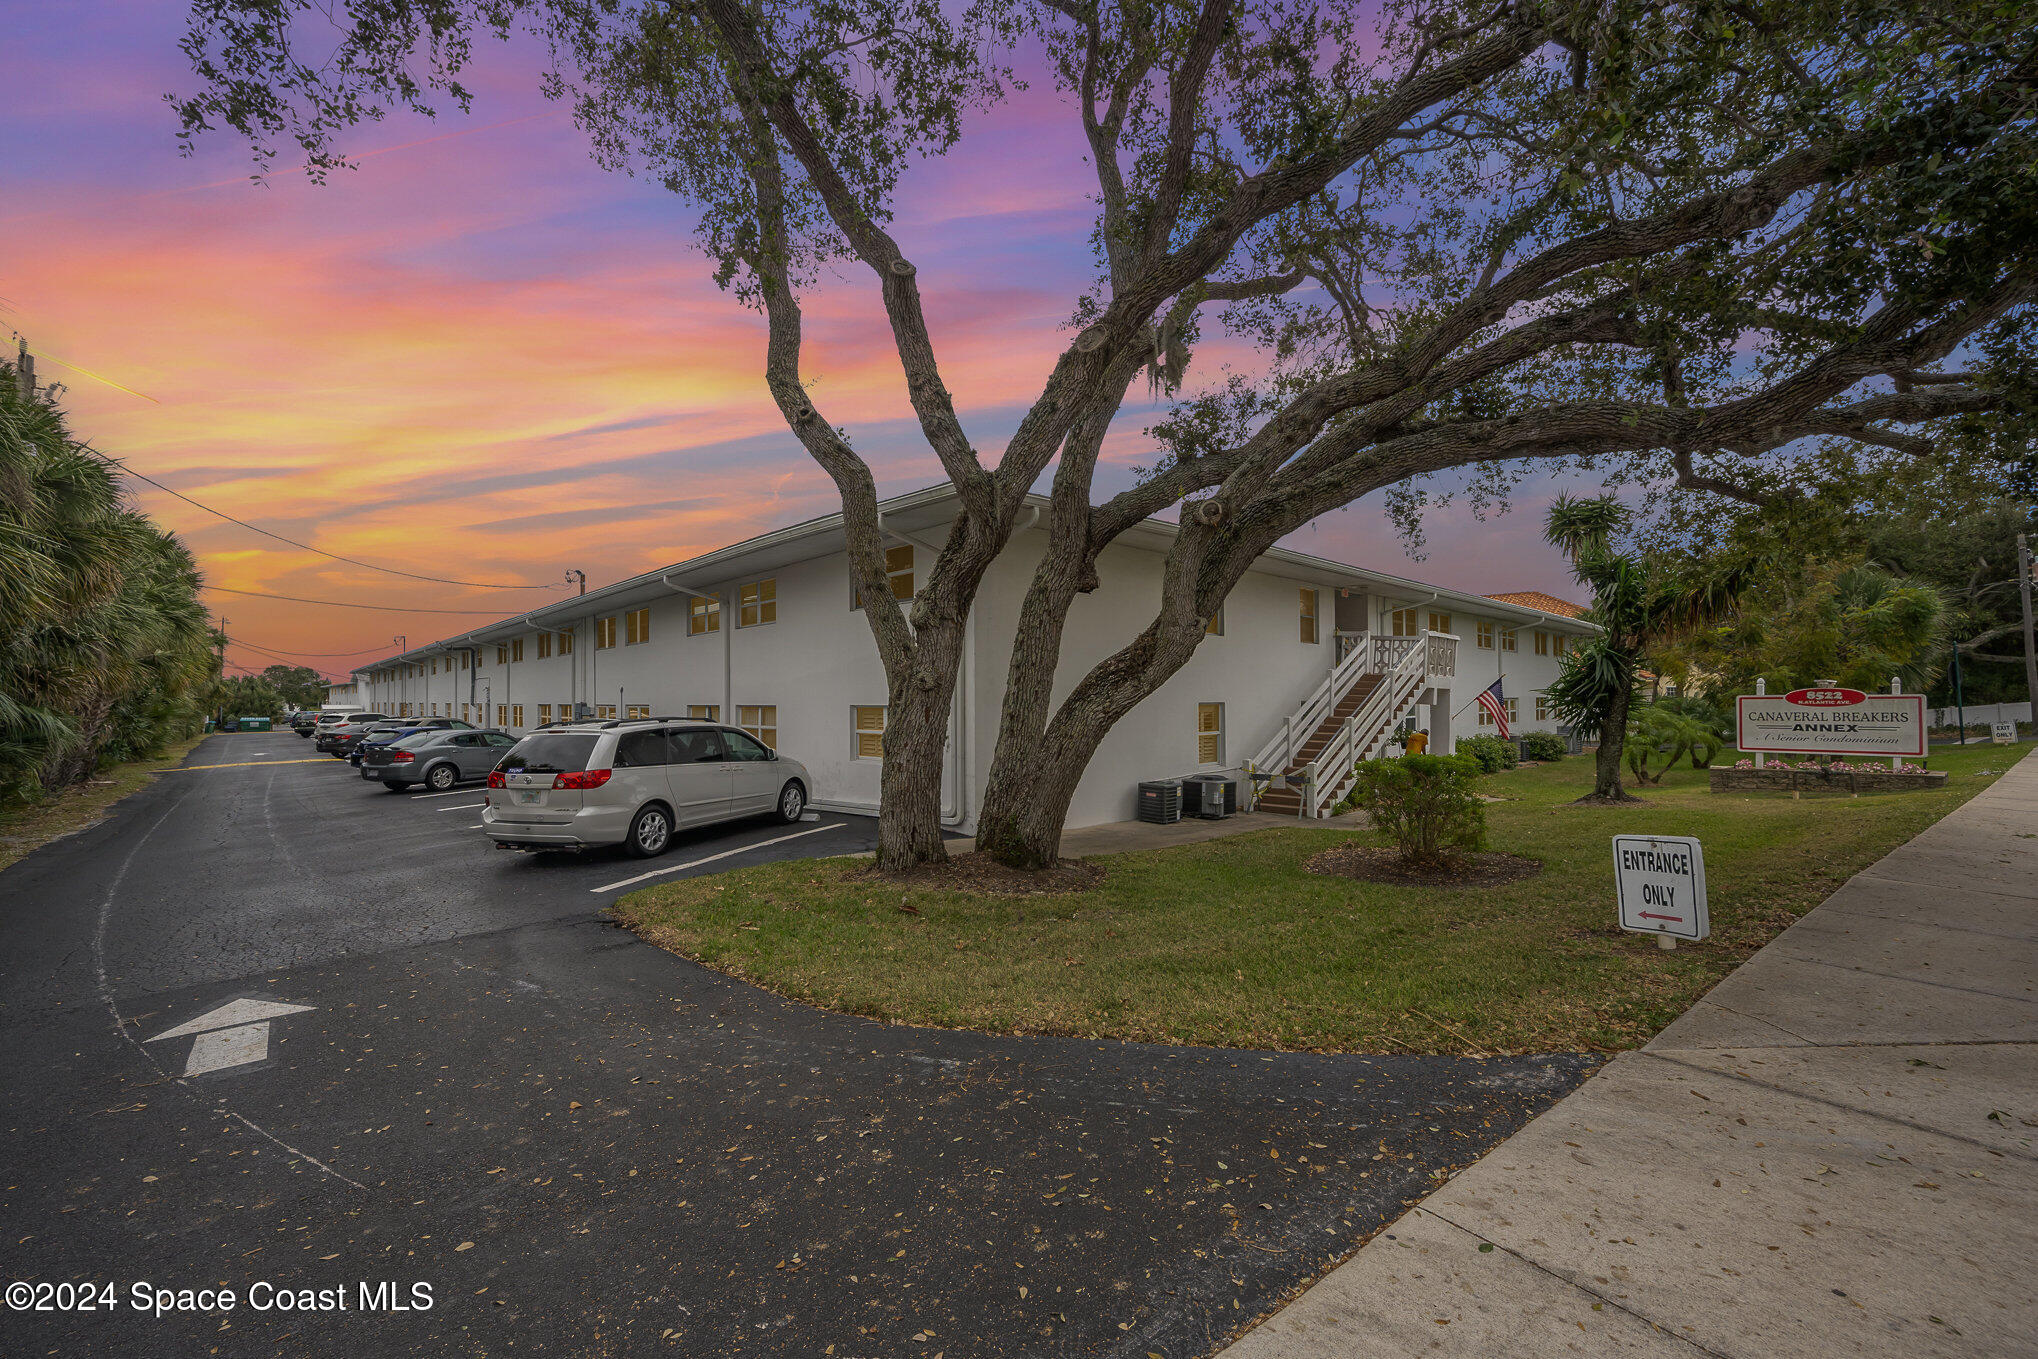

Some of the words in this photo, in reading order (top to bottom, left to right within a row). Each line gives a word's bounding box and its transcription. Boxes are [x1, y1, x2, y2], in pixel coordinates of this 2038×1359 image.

[1806, 691, 1843, 700] 8522
[1748, 711, 1829, 722] CANAVERAL
[1832, 712, 1909, 723] BREAKERS
[1792, 723, 1859, 732] ANNEX
[1814, 734, 1899, 744] Condominium
[1623, 850, 1689, 875] ENTRANCE
[1643, 884, 1674, 907] ONLY
